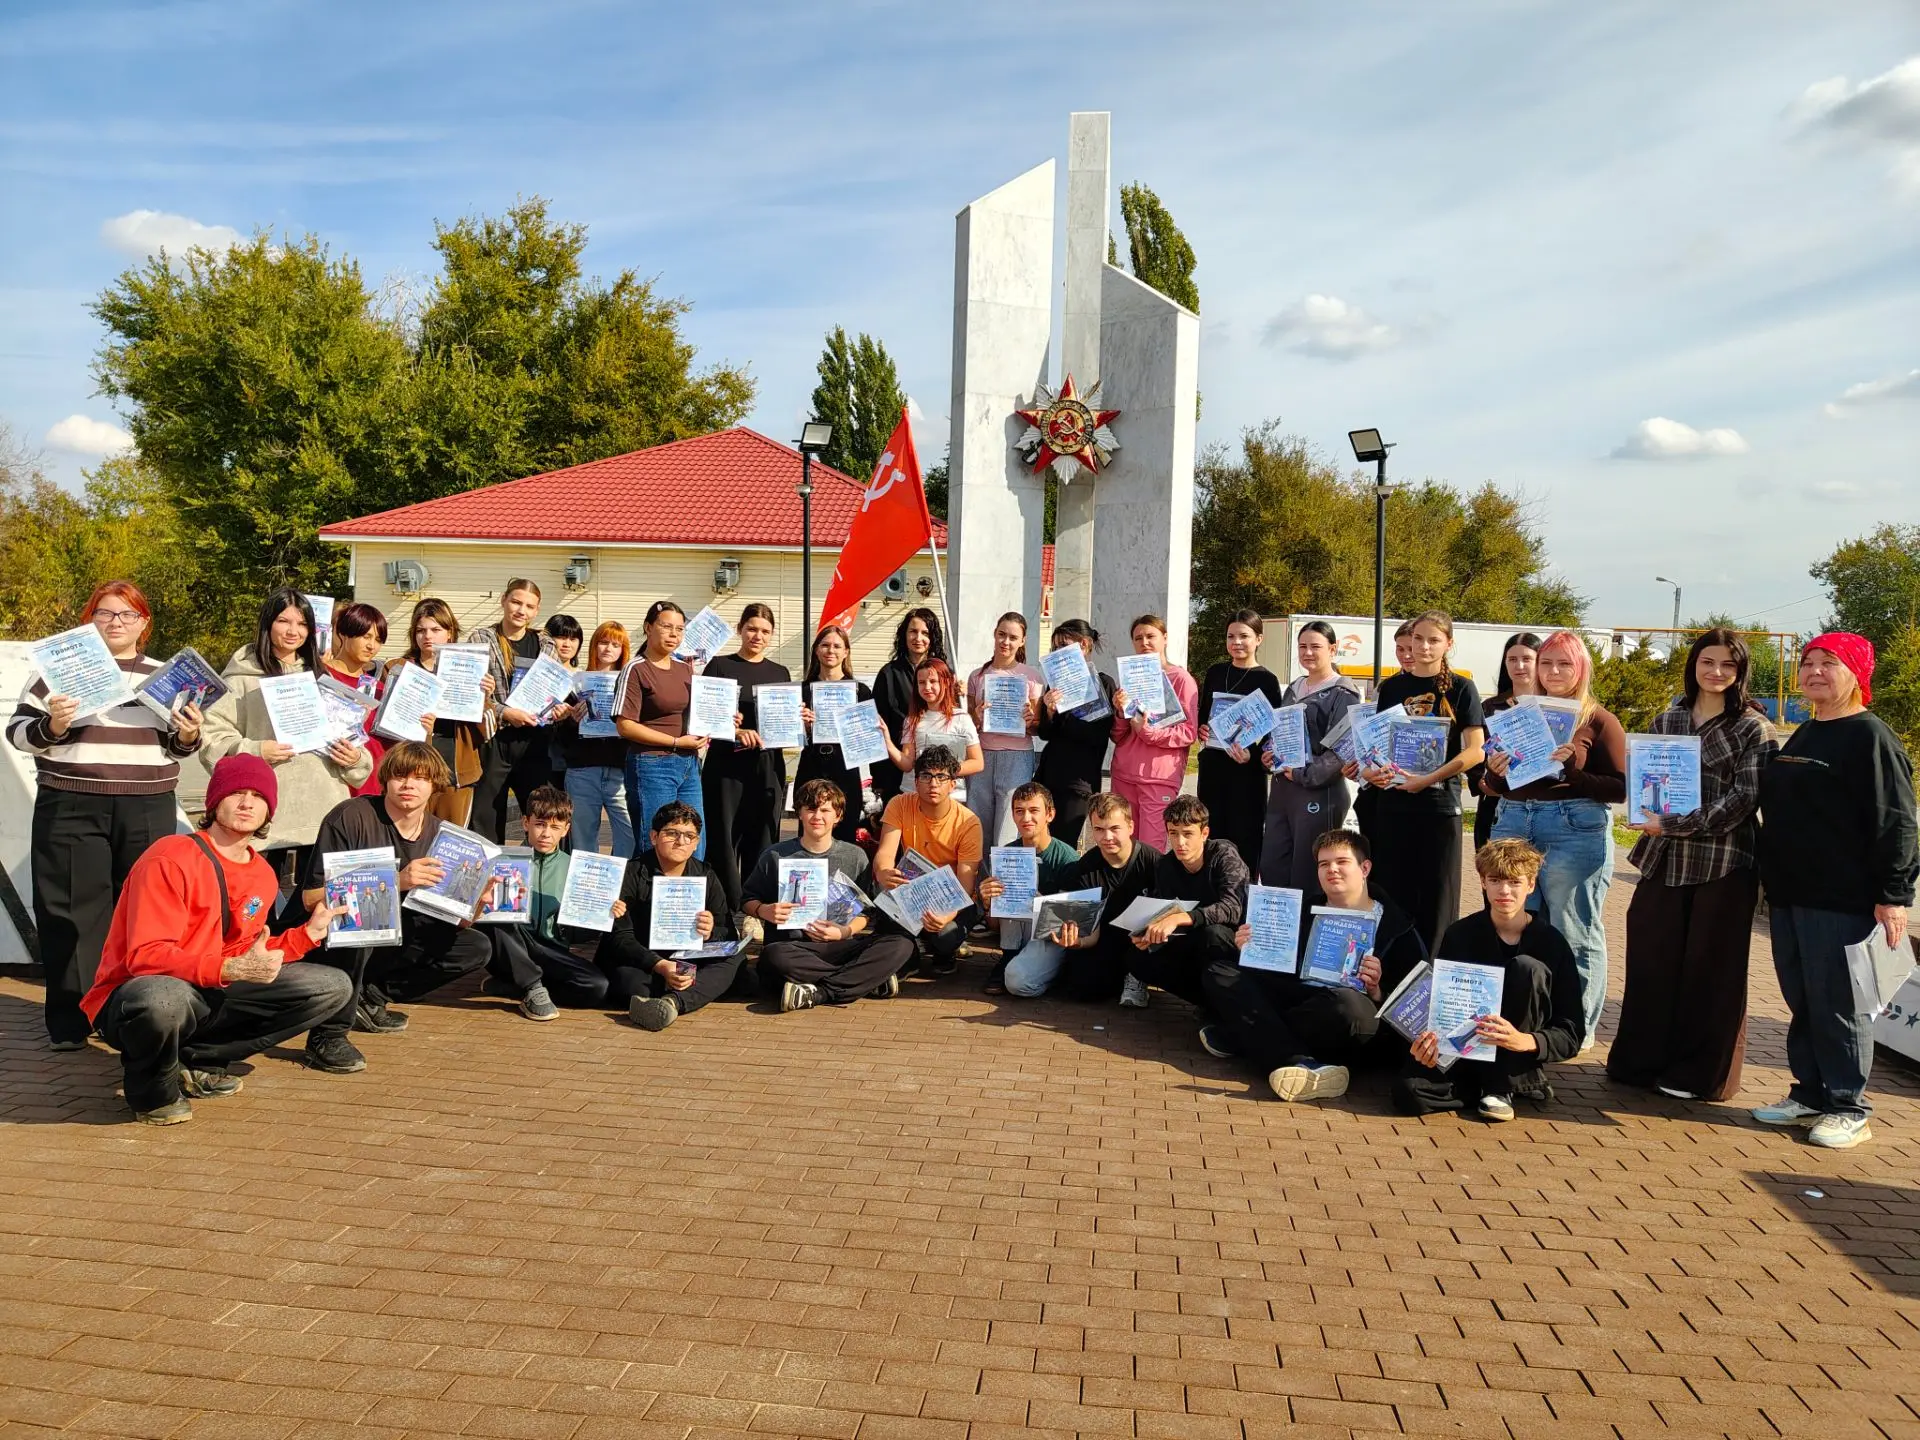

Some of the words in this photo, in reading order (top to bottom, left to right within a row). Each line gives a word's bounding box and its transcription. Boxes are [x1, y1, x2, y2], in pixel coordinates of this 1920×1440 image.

[50, 642, 84, 656] Грамота
[438, 848, 460, 860] ПЛАЩ
[440, 841, 480, 859] ДОЖДЕВИК
[584, 863, 609, 872] Грамота
[333, 875, 379, 884] ДОЖДЕВИК
[1263, 898, 1287, 907] Грамота
[1322, 926, 1345, 935] ПЛАЩ
[1323, 919, 1363, 931] ДОЖДЕВИК
[1451, 975, 1483, 986] Грамота
[1397, 989, 1431, 1022] ДОЖДЕВИК
[1403, 1008, 1424, 1027] ПЛАЩ
